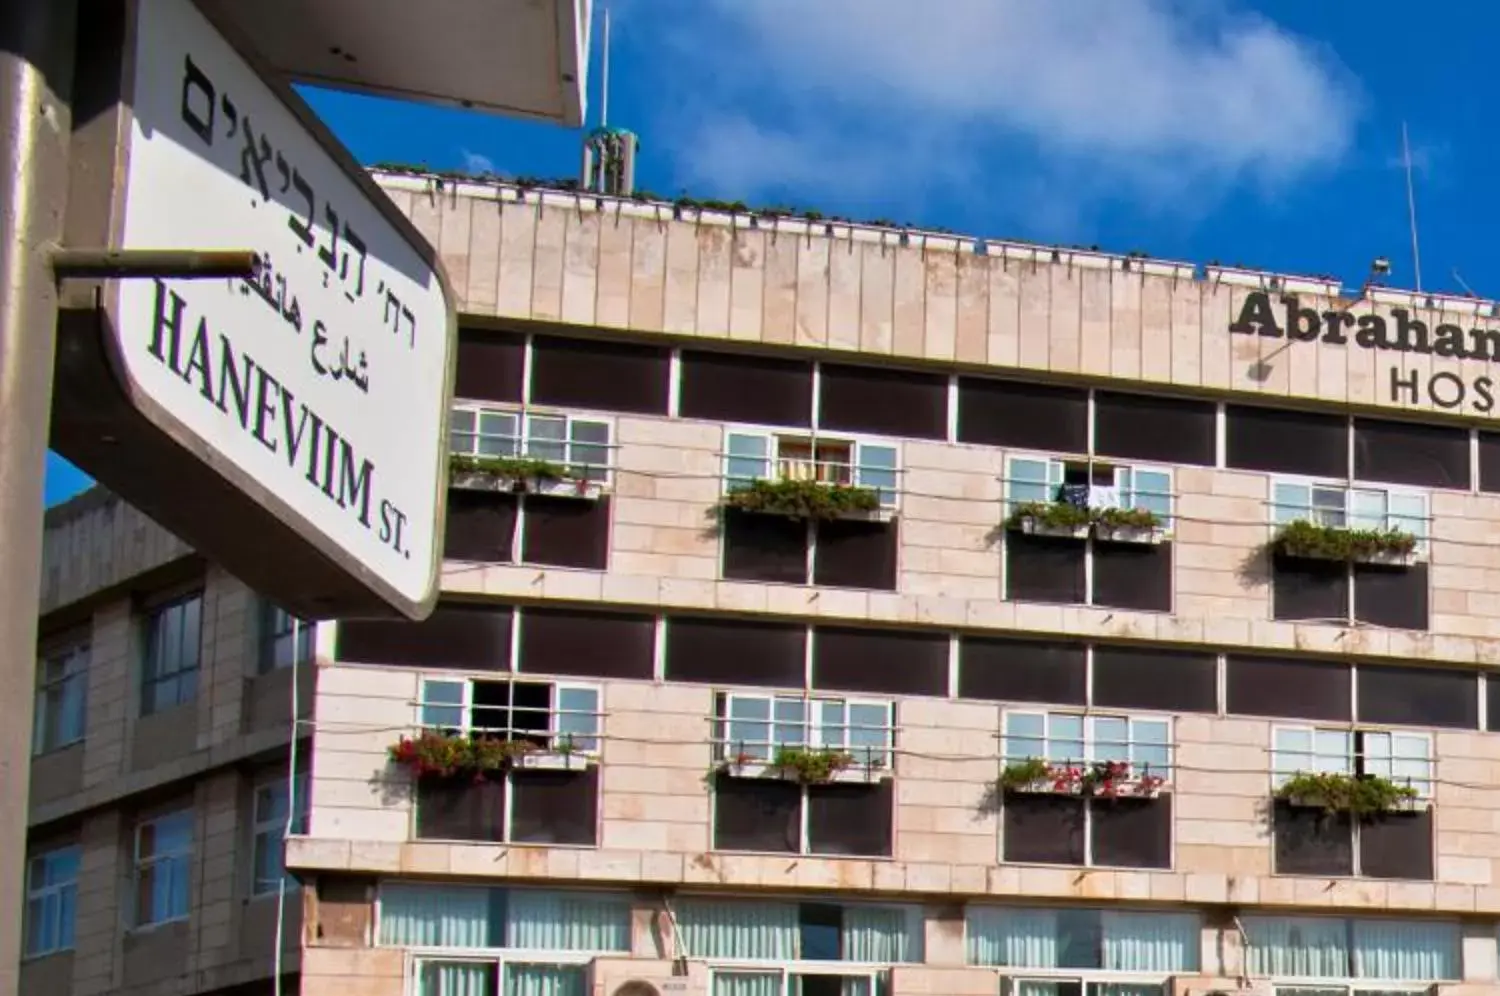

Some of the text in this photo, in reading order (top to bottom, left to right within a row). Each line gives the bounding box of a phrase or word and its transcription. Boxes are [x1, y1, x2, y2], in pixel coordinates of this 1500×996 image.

[147, 276, 411, 560] HANEVIIM ST.
[311, 318, 369, 394] شارع
